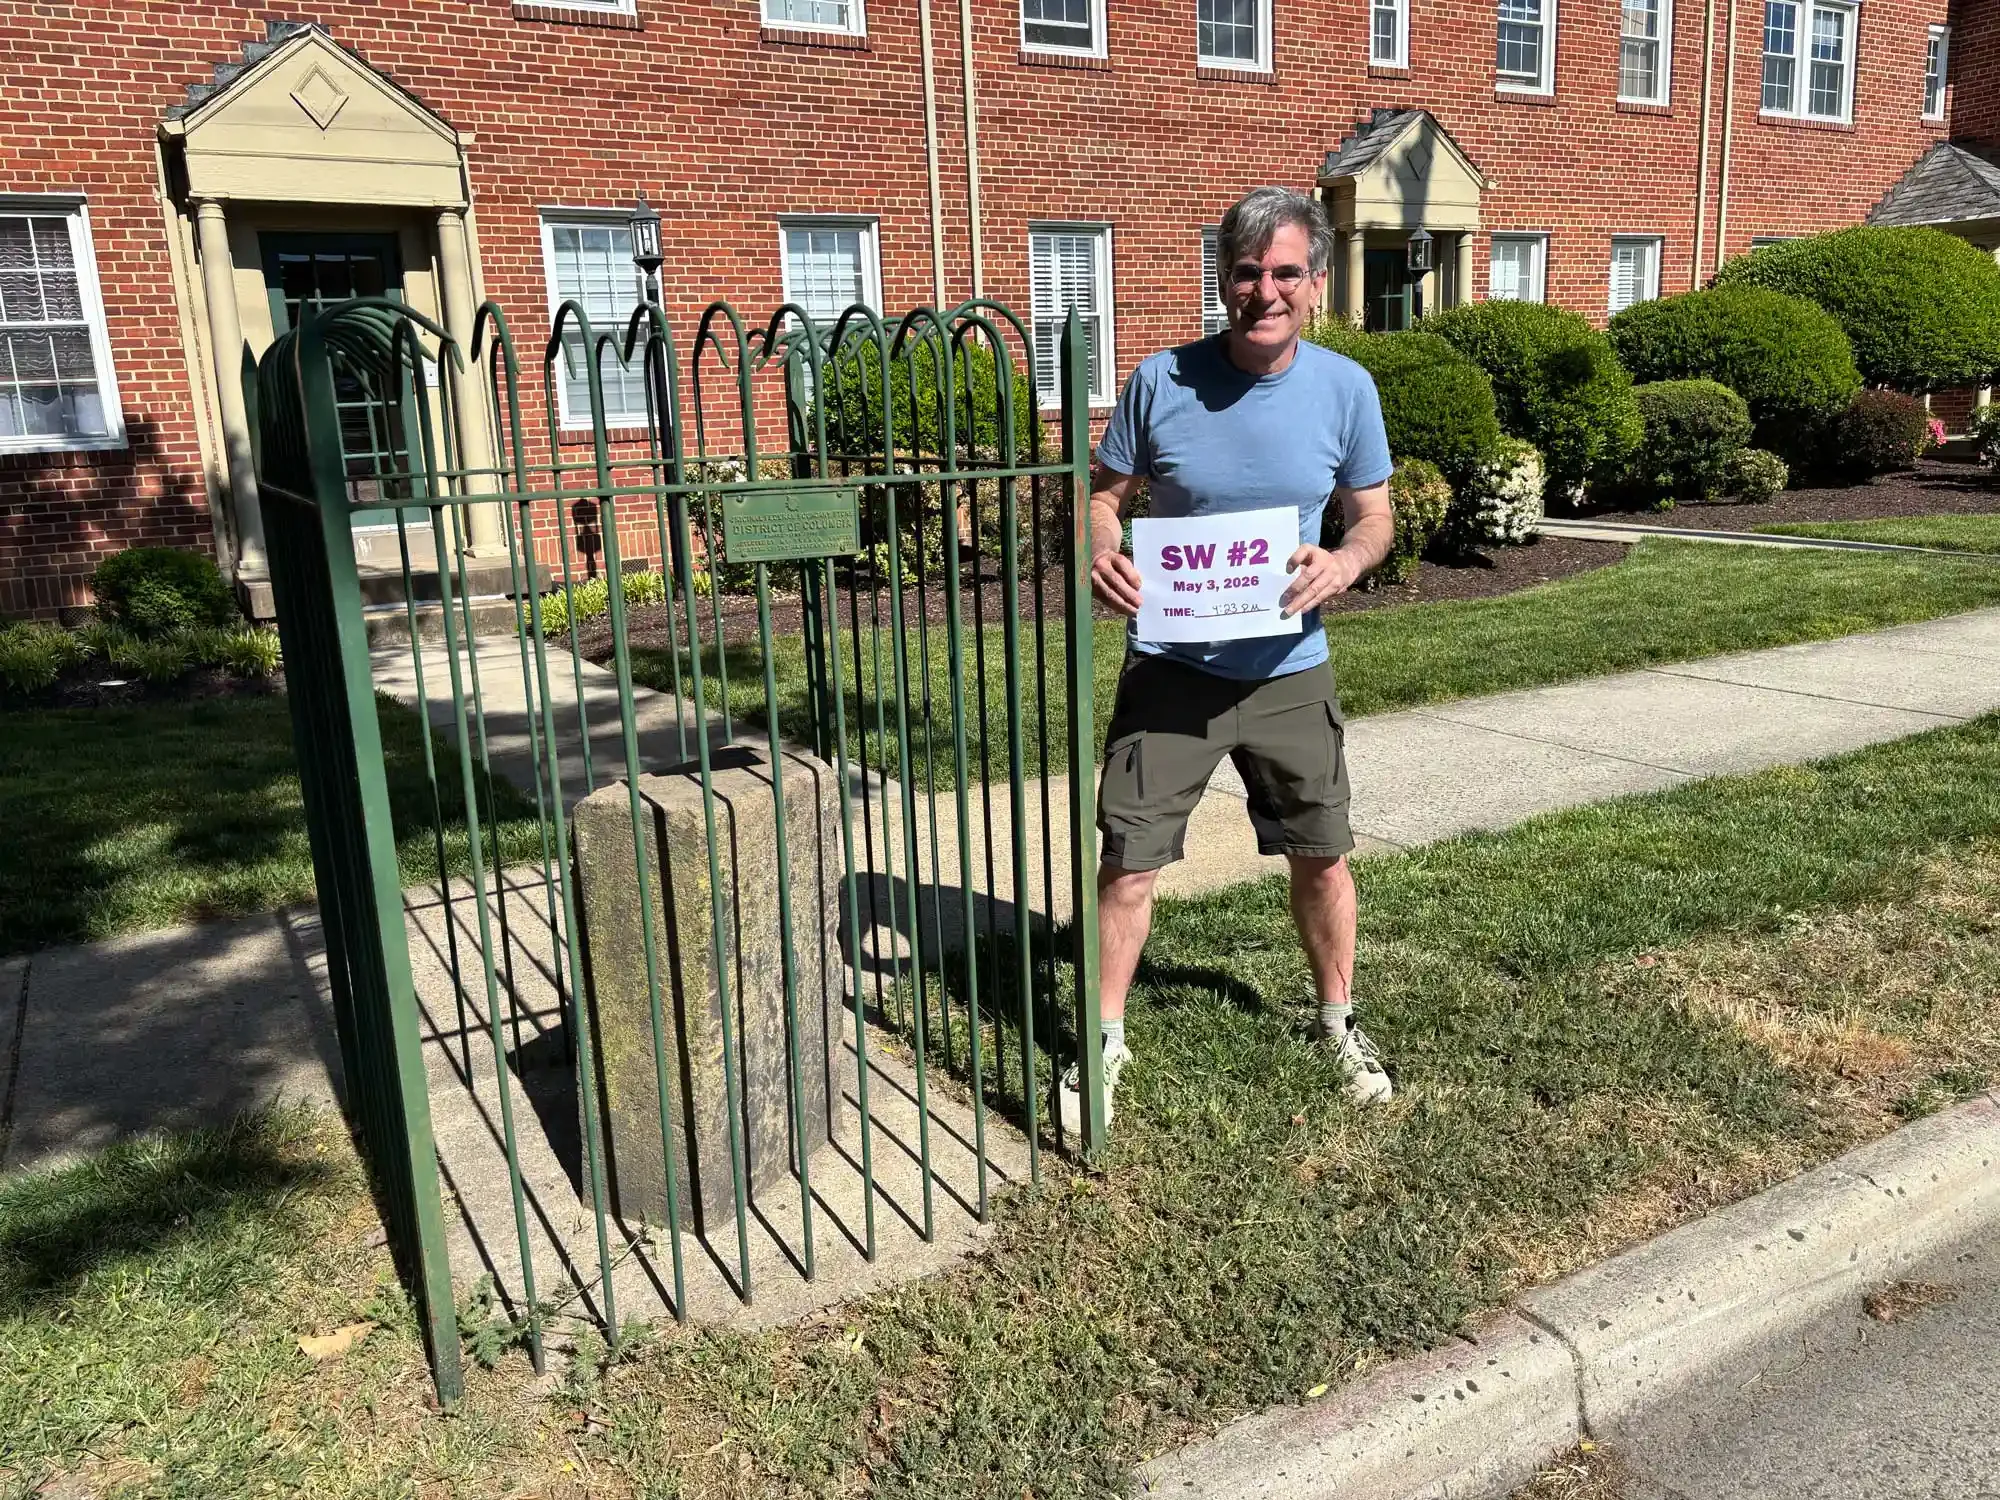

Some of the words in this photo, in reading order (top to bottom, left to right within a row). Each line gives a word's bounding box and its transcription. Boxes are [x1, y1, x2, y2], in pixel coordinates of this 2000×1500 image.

[733, 524, 784, 535] DISTRICT
[787, 522, 800, 531] OF
[803, 519, 852, 530] COLUMBIA
[1161, 543, 1216, 571] SW
[1227, 538, 1269, 567] #2
[1173, 579, 1203, 593] May
[1206, 579, 1220, 592] 3,
[1223, 576, 1259, 589] 2026
[1163, 607, 1195, 617] TIME:
[1212, 603, 1237, 615] 4:23
